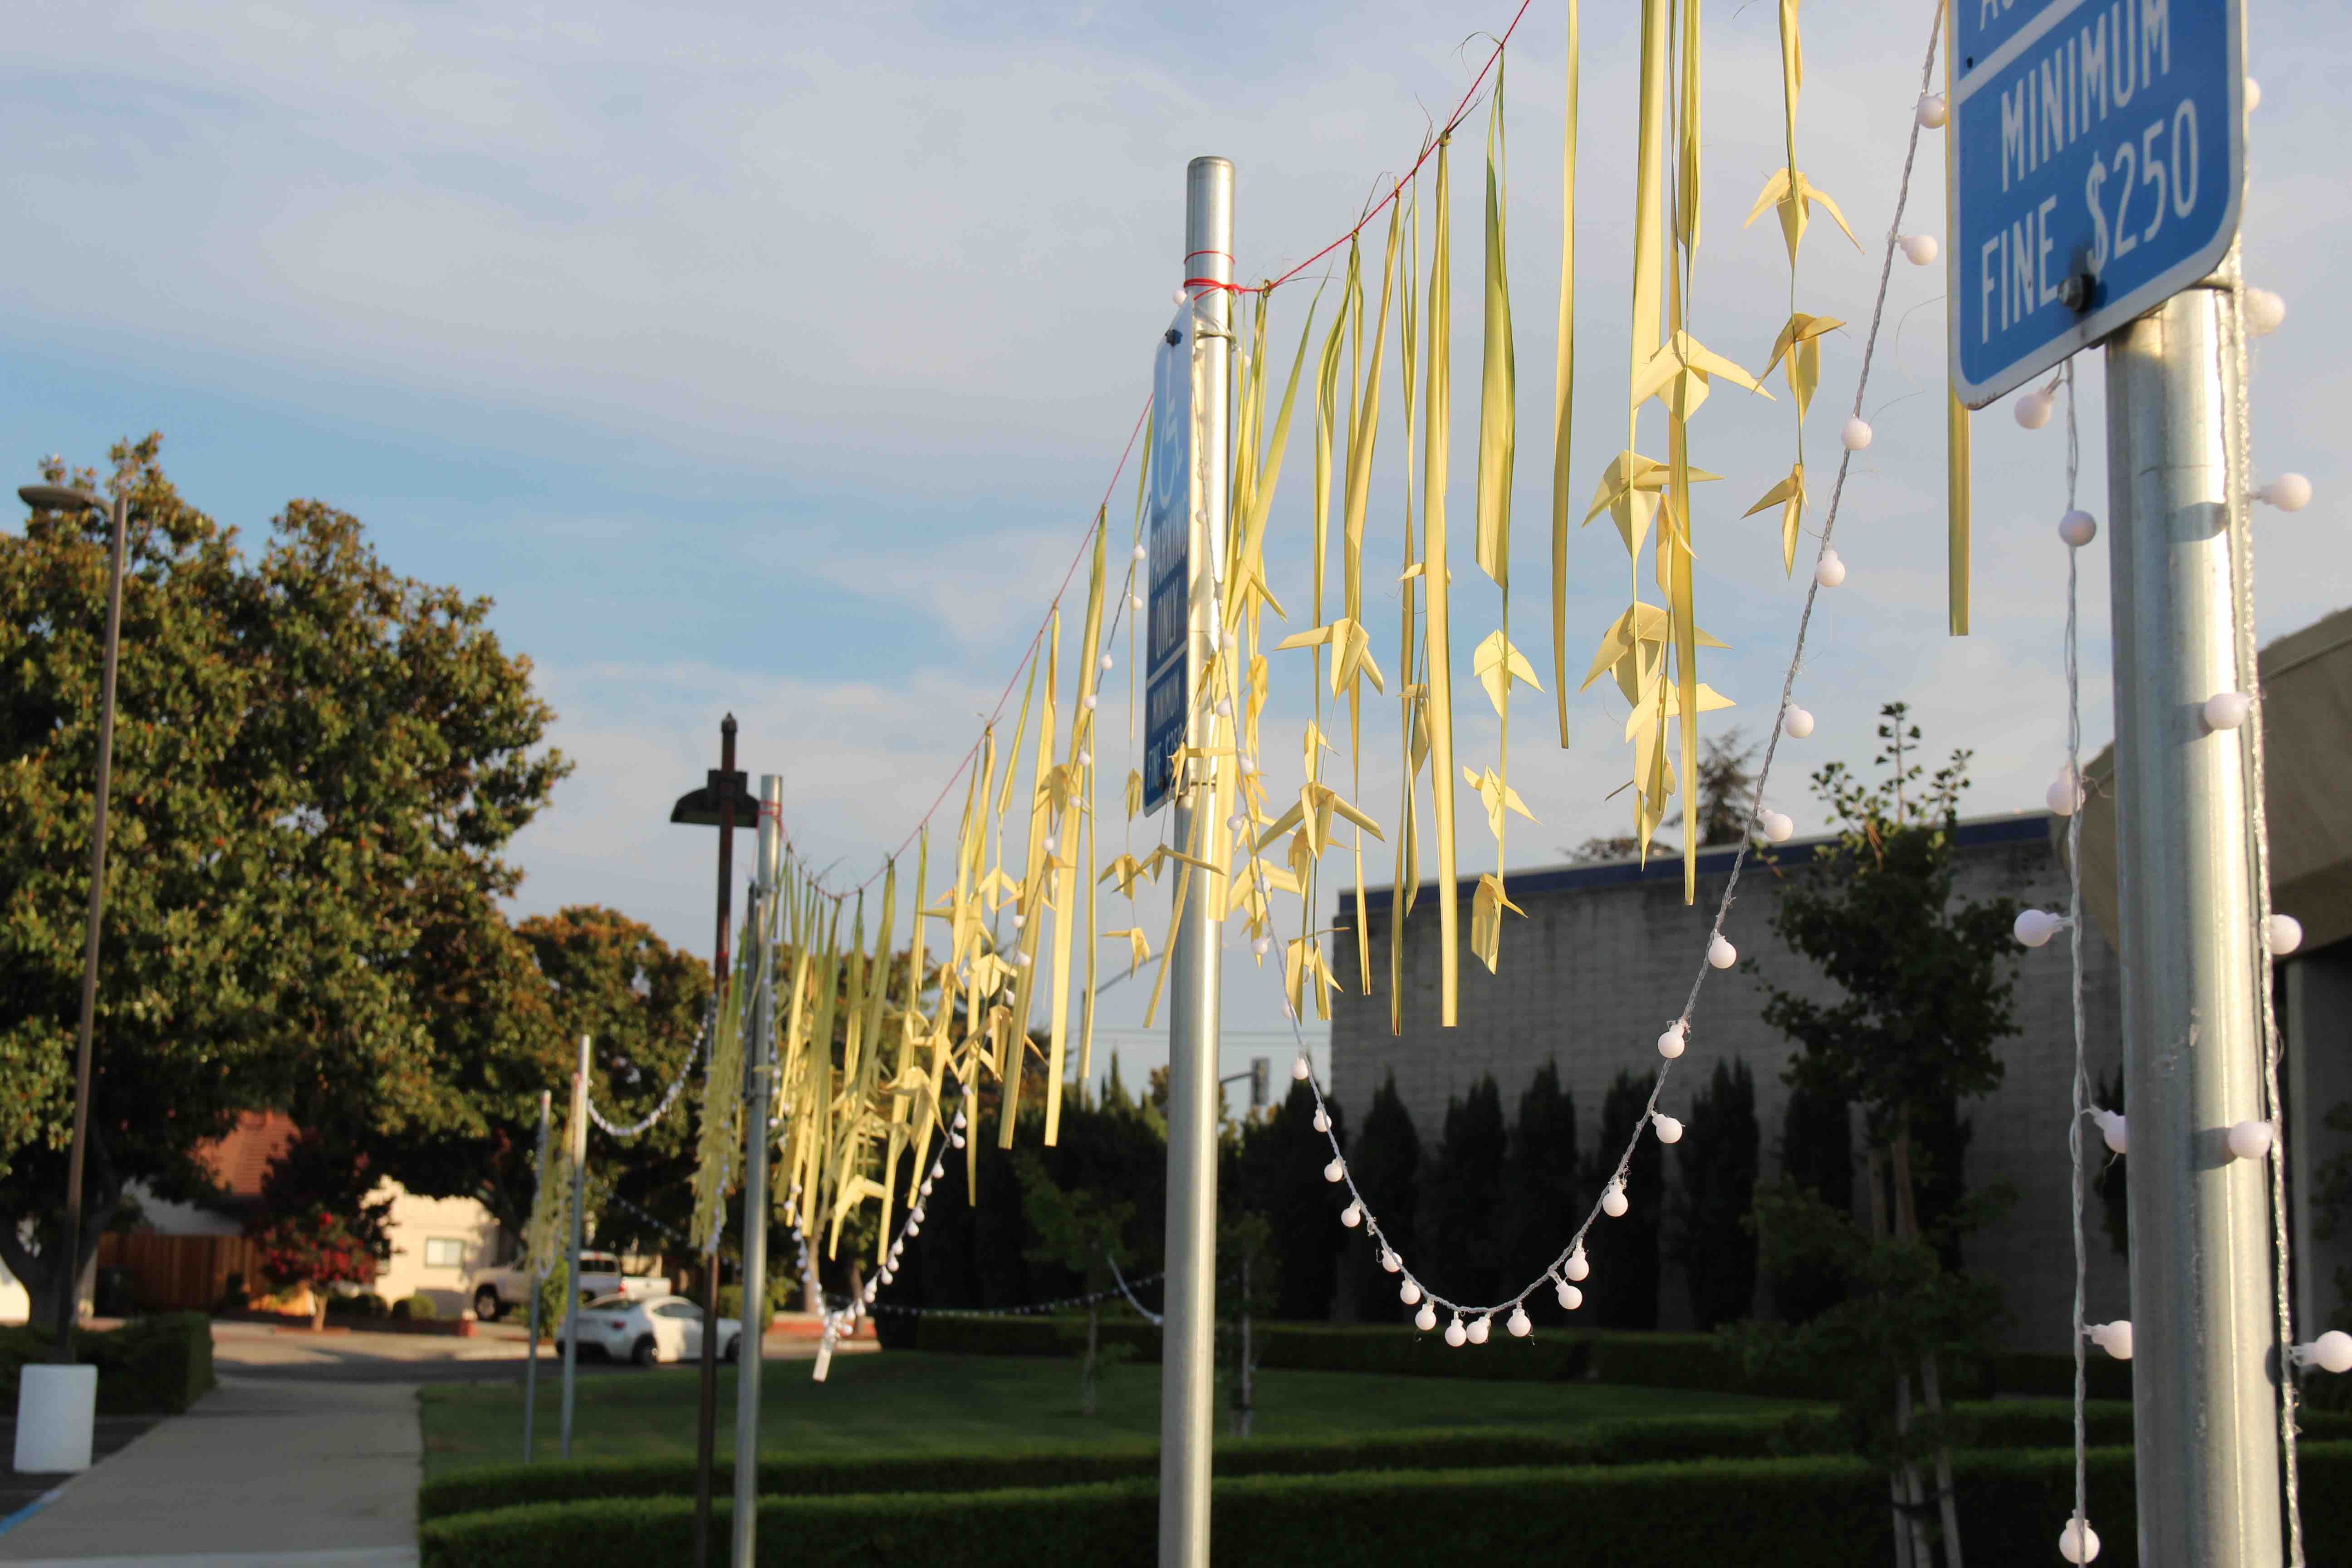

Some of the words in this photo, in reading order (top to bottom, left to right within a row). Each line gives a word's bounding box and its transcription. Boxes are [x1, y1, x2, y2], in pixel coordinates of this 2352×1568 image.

[2001, 0, 2170, 193] MINIMUM
[1982, 194, 2057, 344] FINE
[2086, 98, 2199, 282] $250
[1156, 577, 1179, 659] ONLY
